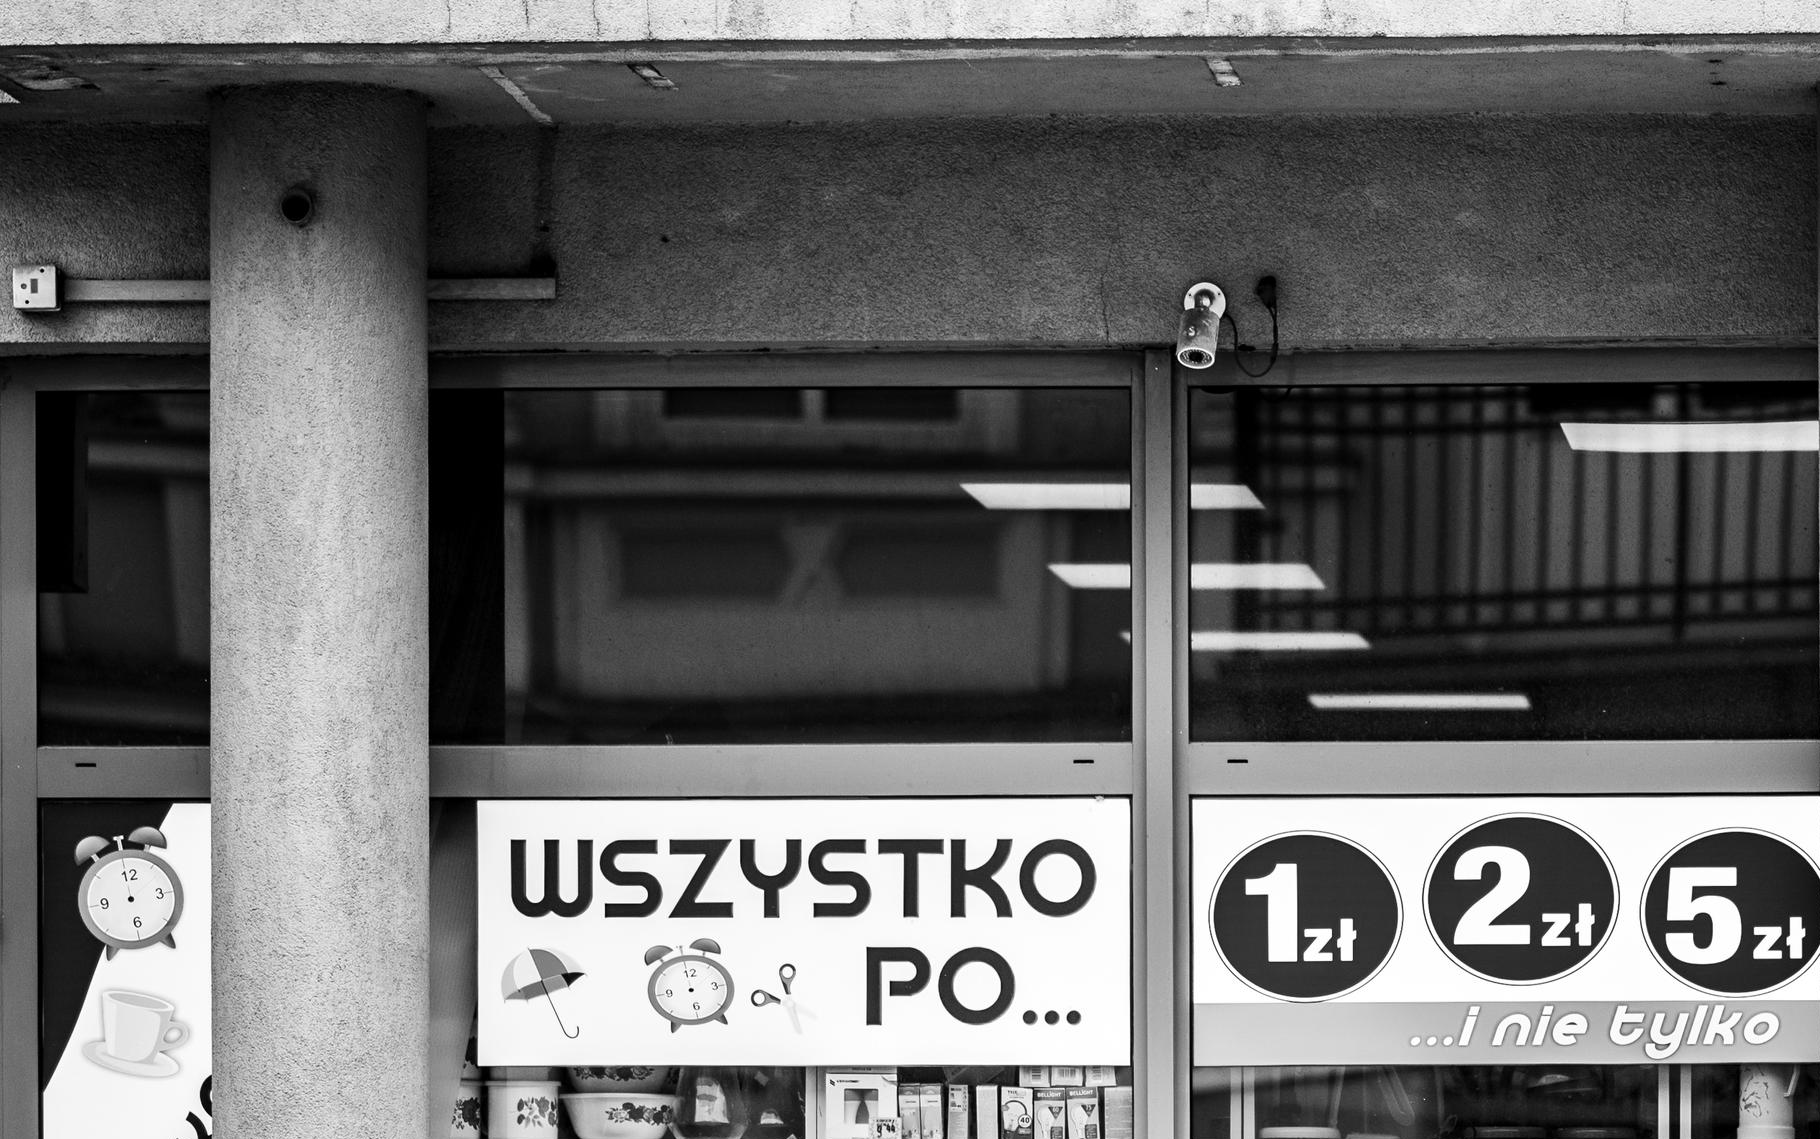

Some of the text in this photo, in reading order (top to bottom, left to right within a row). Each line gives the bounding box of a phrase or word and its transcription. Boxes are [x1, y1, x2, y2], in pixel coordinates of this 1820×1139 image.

[122, 869, 138, 882] 12
[510, 838, 1097, 918] WSZYSTKO
[100, 888, 164, 909] 9 3
[133, 917, 142, 928] 6
[684, 969, 696, 978] 12
[666, 982, 718, 997] 9 3
[866, 947, 1083, 1026] PO...
[693, 1002, 700, 1010] 6
[1492, 1005, 1588, 1047] nie
[1608, 1004, 1779, 1059] tylko
